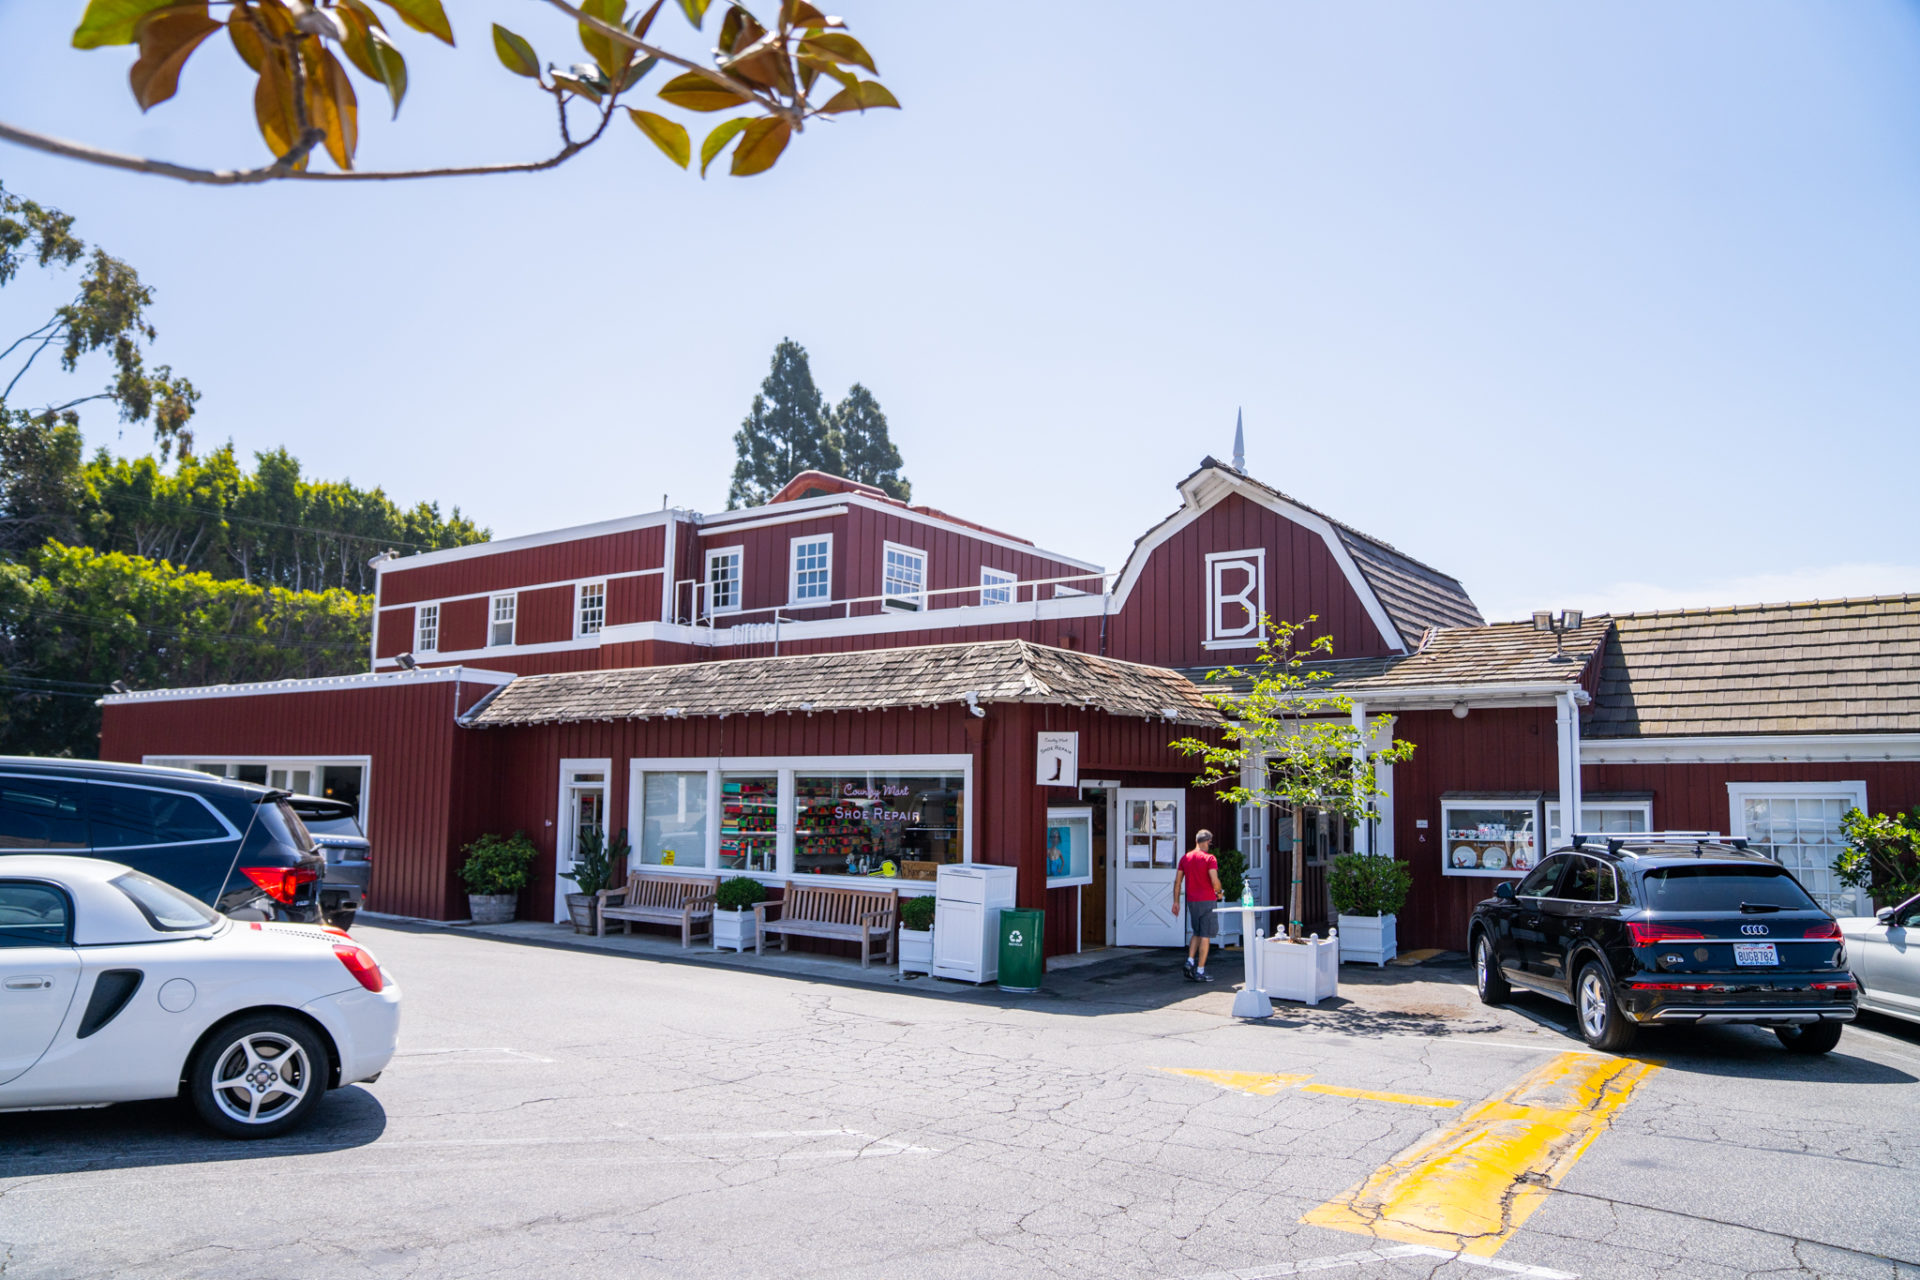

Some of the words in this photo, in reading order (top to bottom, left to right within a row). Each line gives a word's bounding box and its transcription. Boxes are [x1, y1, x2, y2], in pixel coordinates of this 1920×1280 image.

[1214, 560, 1257, 638] B
[843, 783, 880, 800] Country
[882, 784, 909, 796] Mart
[835, 806, 869, 820] SHOE
[873, 807, 920, 822] REPAIR
[1737, 951, 1775, 962] 8UGB782
